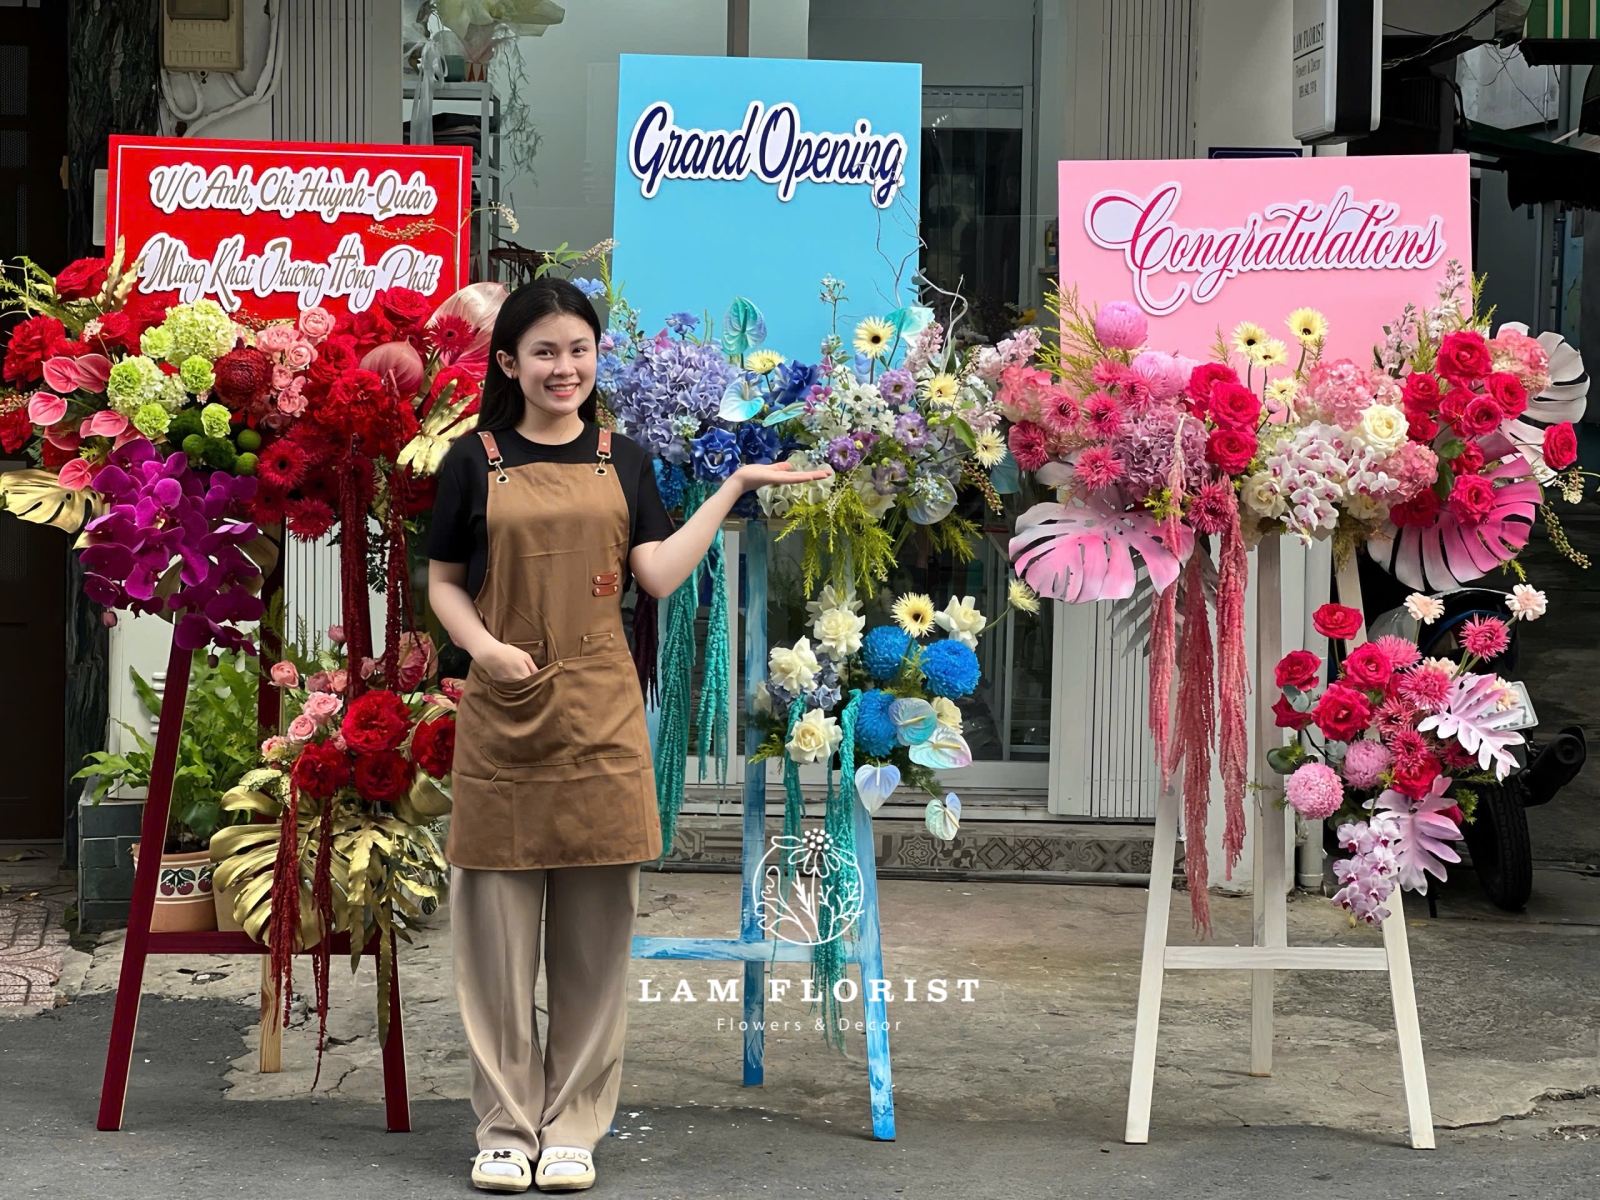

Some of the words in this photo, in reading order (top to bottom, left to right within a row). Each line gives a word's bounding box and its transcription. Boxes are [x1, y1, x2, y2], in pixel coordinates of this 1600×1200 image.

[260, 170, 295, 213] Chị
[633, 104, 759, 194] Grand
[759, 106, 903, 205] Opening
[140, 237, 205, 304] Mừng
[210, 238, 253, 308] Khai
[259, 241, 326, 308] Trương
[329, 236, 376, 309] Hồng
[382, 248, 438, 292] Phát
[1091, 186, 1441, 311] Congratulations
